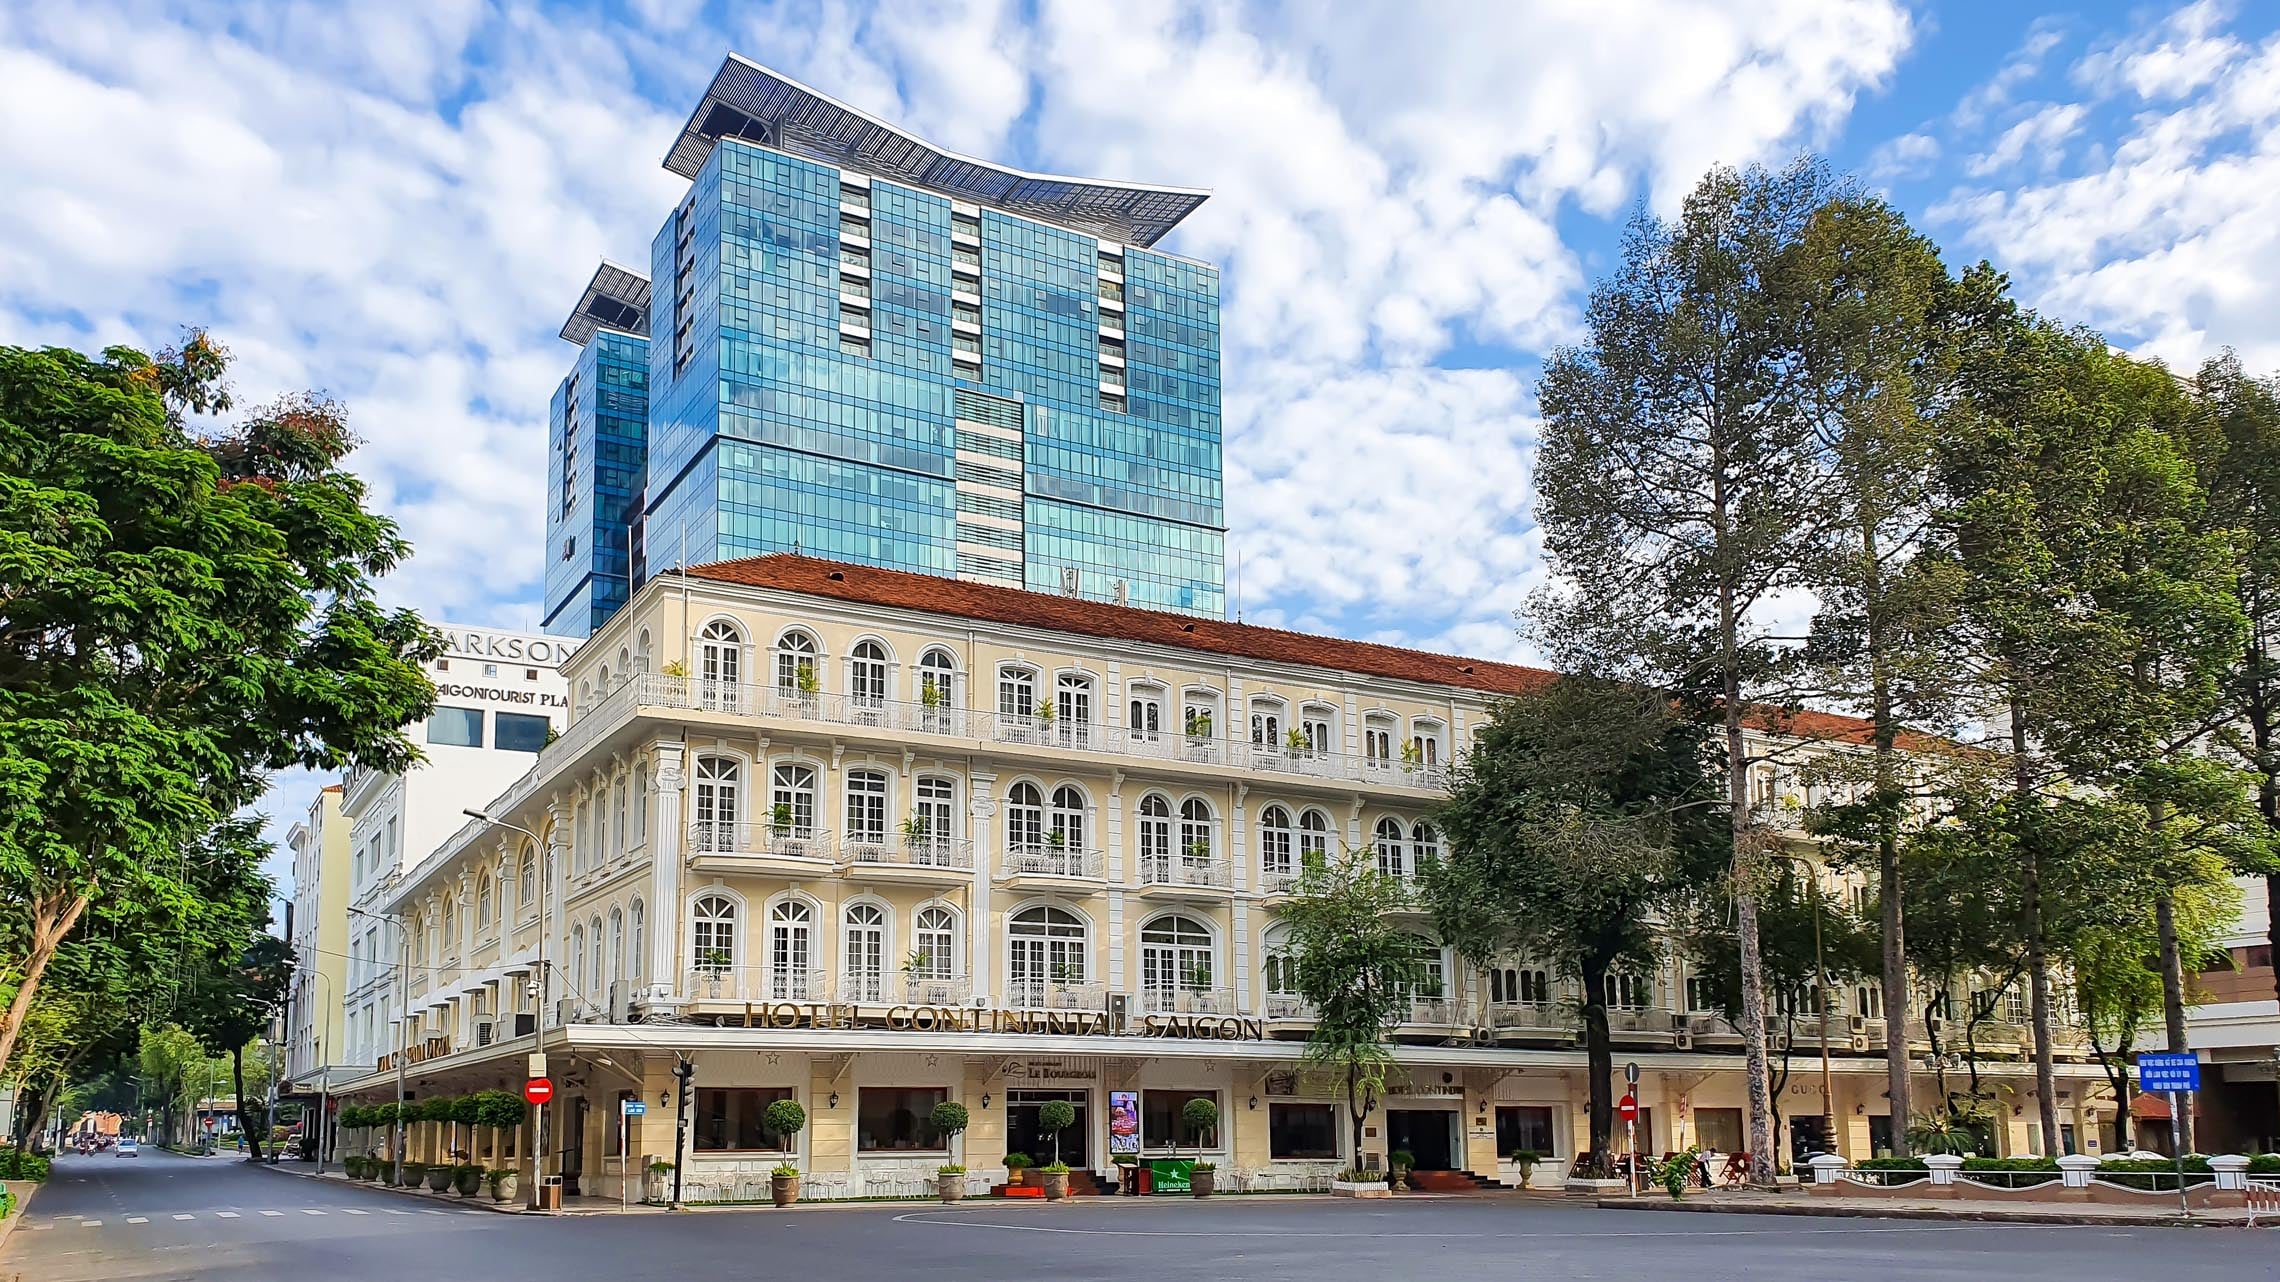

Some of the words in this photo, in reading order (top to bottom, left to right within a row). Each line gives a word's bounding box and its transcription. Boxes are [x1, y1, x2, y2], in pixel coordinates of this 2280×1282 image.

[447, 631, 579, 663] ARKSON
[437, 683, 536, 705] AIGONTOURIST
[743, 1001, 868, 1031] HOTEL
[886, 1005, 1128, 1037] CONTINENTAL
[1143, 1014, 1263, 1042] SAIGON
[1158, 1180, 1191, 1189] Heineken
